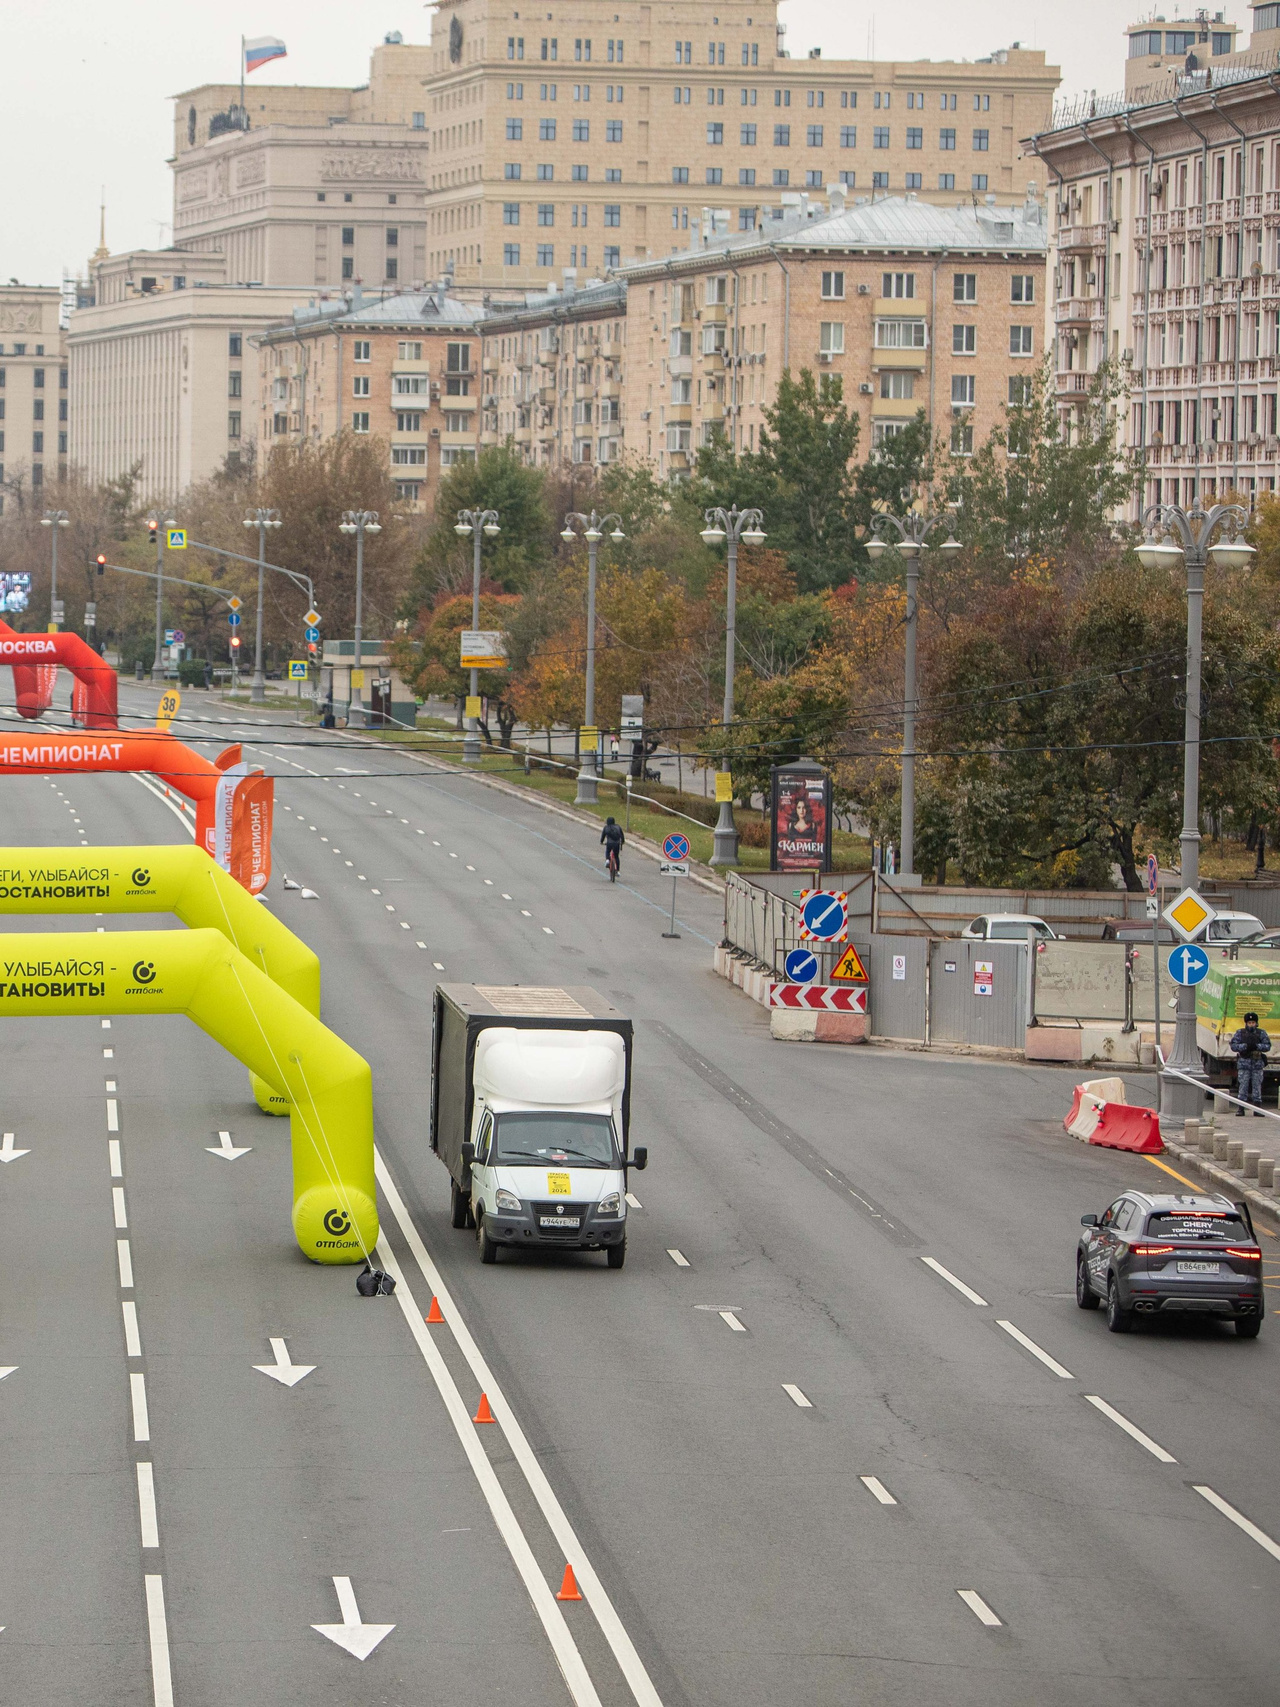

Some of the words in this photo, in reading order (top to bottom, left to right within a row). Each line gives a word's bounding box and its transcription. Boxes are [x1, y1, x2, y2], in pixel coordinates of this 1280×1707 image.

[163, 696, 176, 712] 38
[250, 802, 262, 872] ЧЕМПИОНАТ
[778, 840, 824, 853] КАРМЕН
[29, 866, 109, 881] УЛЫБАЙСЯ
[4, 958, 104, 977] УЛЫБАЙСЯ
